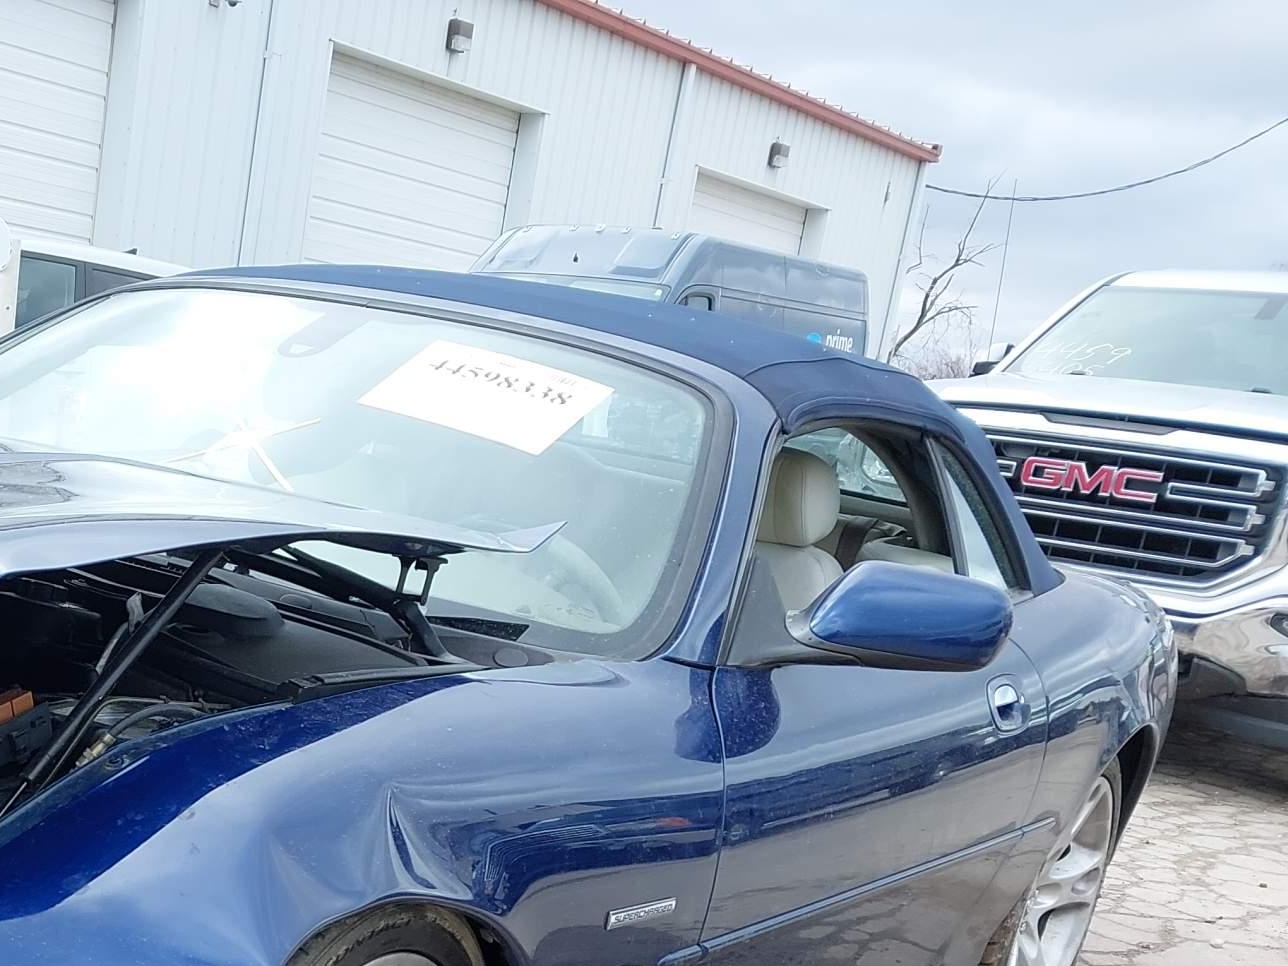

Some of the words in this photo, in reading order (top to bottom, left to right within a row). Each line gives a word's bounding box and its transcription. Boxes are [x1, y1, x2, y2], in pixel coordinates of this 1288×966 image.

[428, 360, 573, 405] 44598338
[1020, 456, 1164, 503] GMC
[614, 904, 673, 922] SUPERCHARGED
